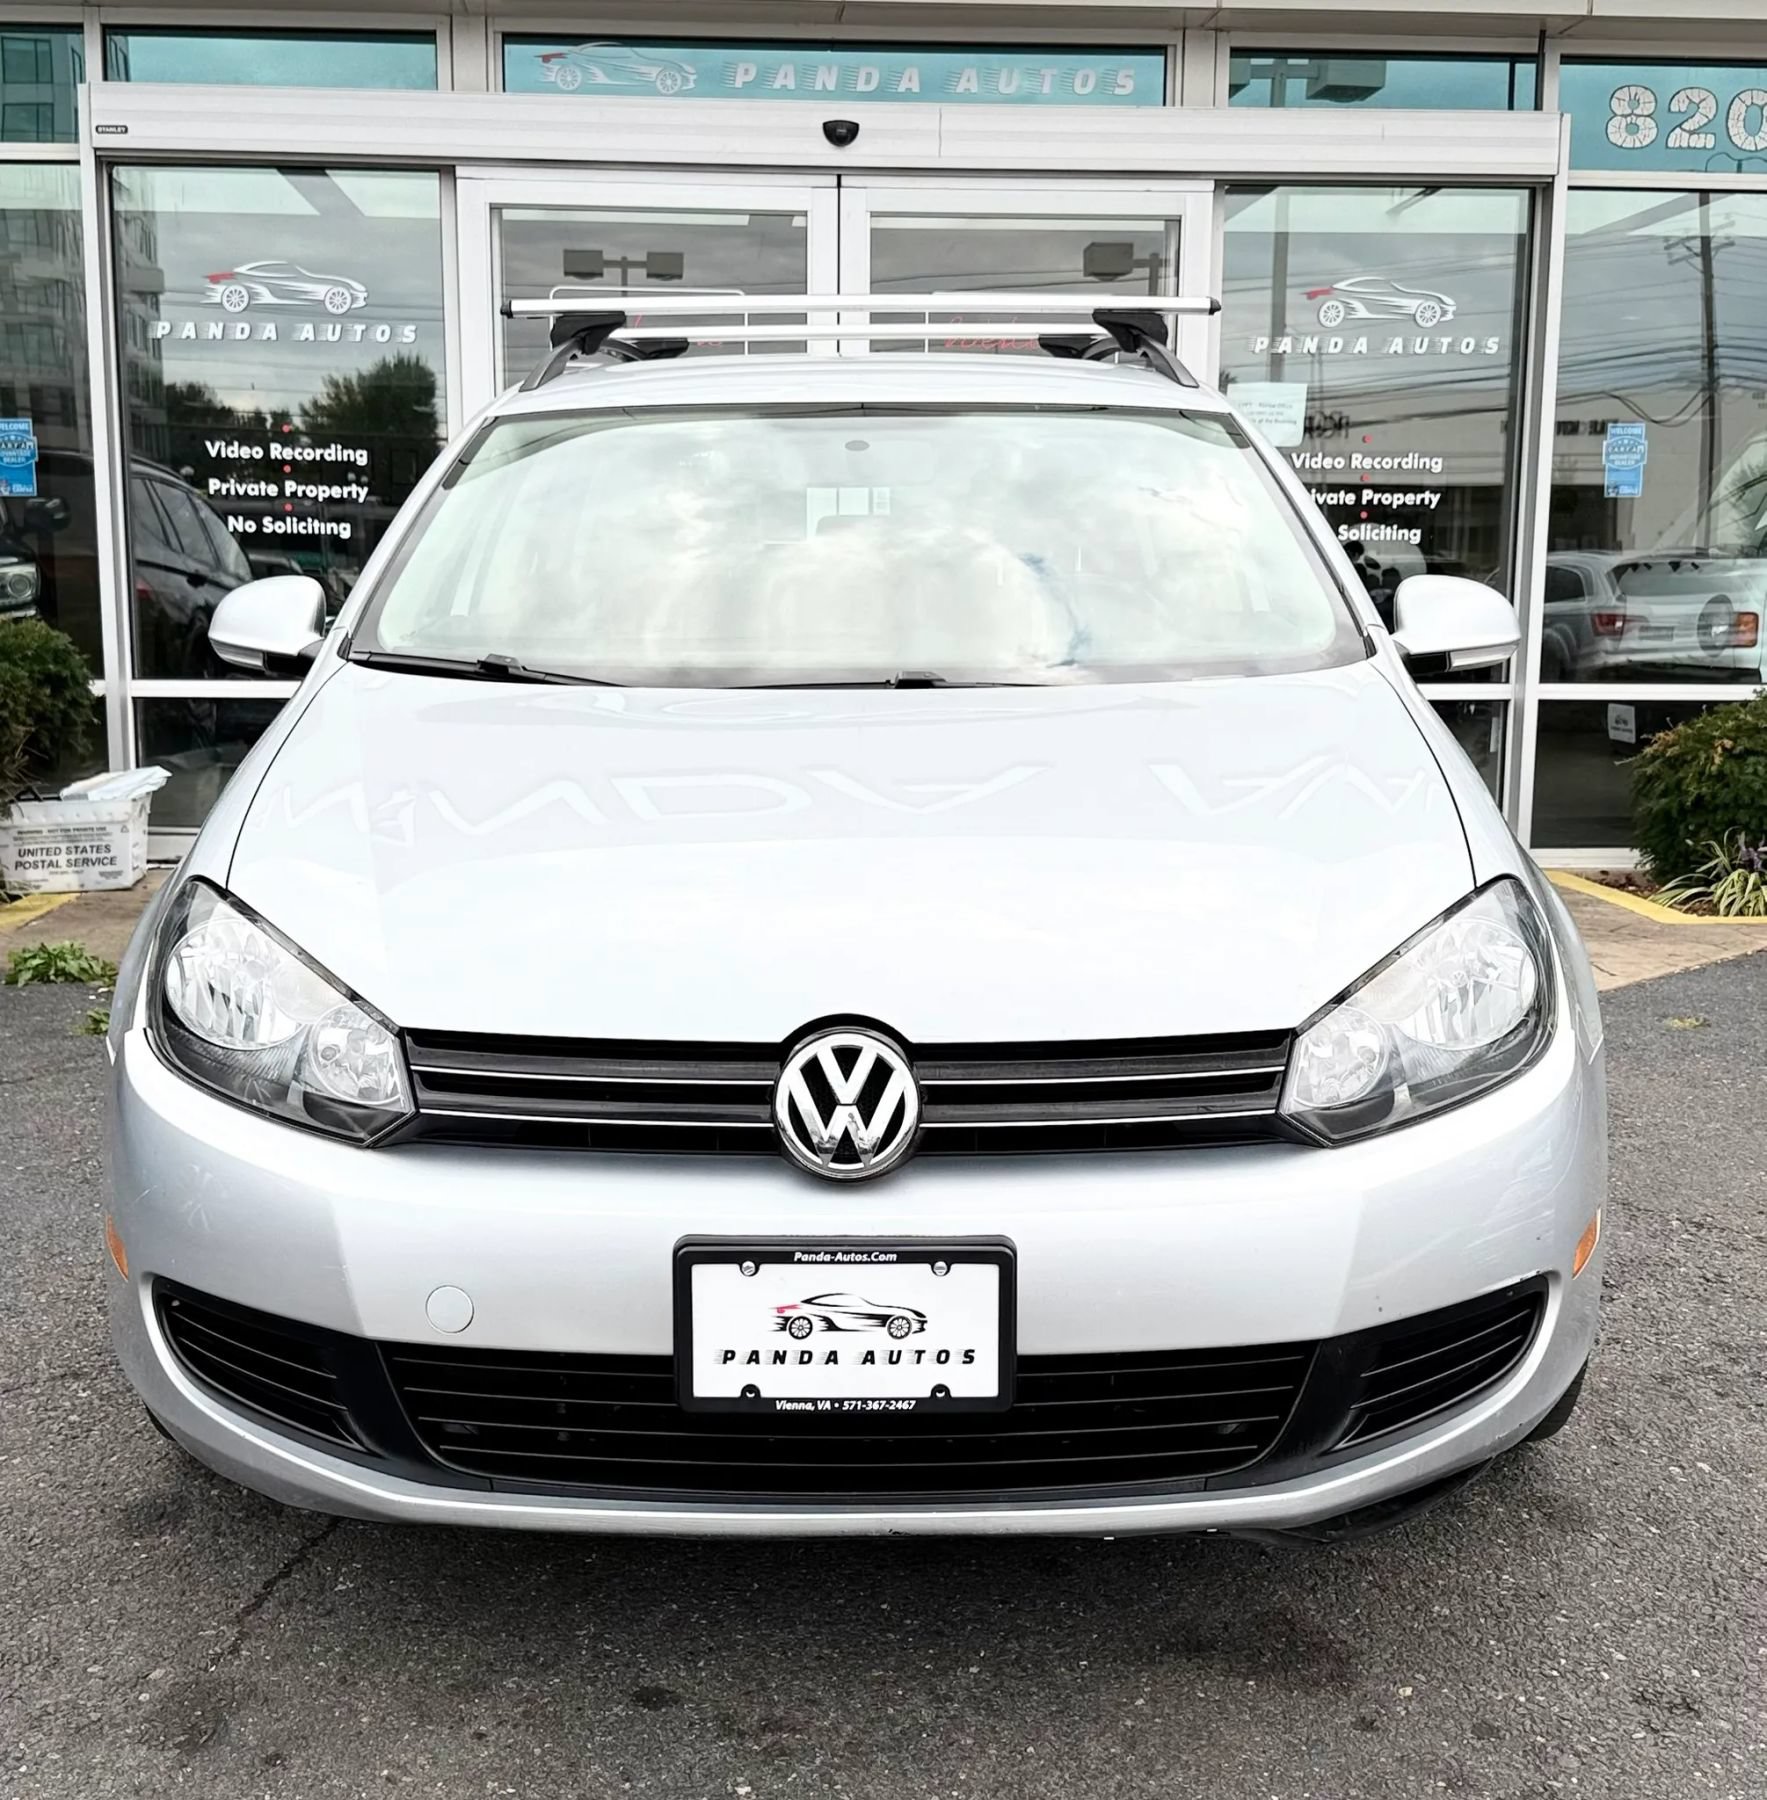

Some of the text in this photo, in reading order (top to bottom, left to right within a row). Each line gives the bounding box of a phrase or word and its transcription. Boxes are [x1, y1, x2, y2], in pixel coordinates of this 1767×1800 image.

[732, 62, 1135, 96] PANDA AUTOS
[1605, 83, 1767, 152] 820
[155, 320, 418, 344] PANDA AUTOS
[1253, 336, 1500, 355] PANDA AUTOS
[204, 440, 369, 467] Video Recording
[1290, 452, 1443, 474] Video Recording
[207, 477, 369, 504] Private Property
[1310, 487, 1441, 510] ivate Property
[227, 514, 352, 540] No Soliciting
[1337, 523, 1422, 545] Soliciting
[18, 844, 112, 858] UNITED STATES
[14, 856, 117, 871] POSTAL SERVICE
[783, 1033, 911, 1171] VW
[793, 1251, 898, 1263] Panda-Autos.Com
[721, 1348, 976, 1365] PANDA AUTOS
[775, 1400, 917, 1411] Vienna, VA 571-367-2467
